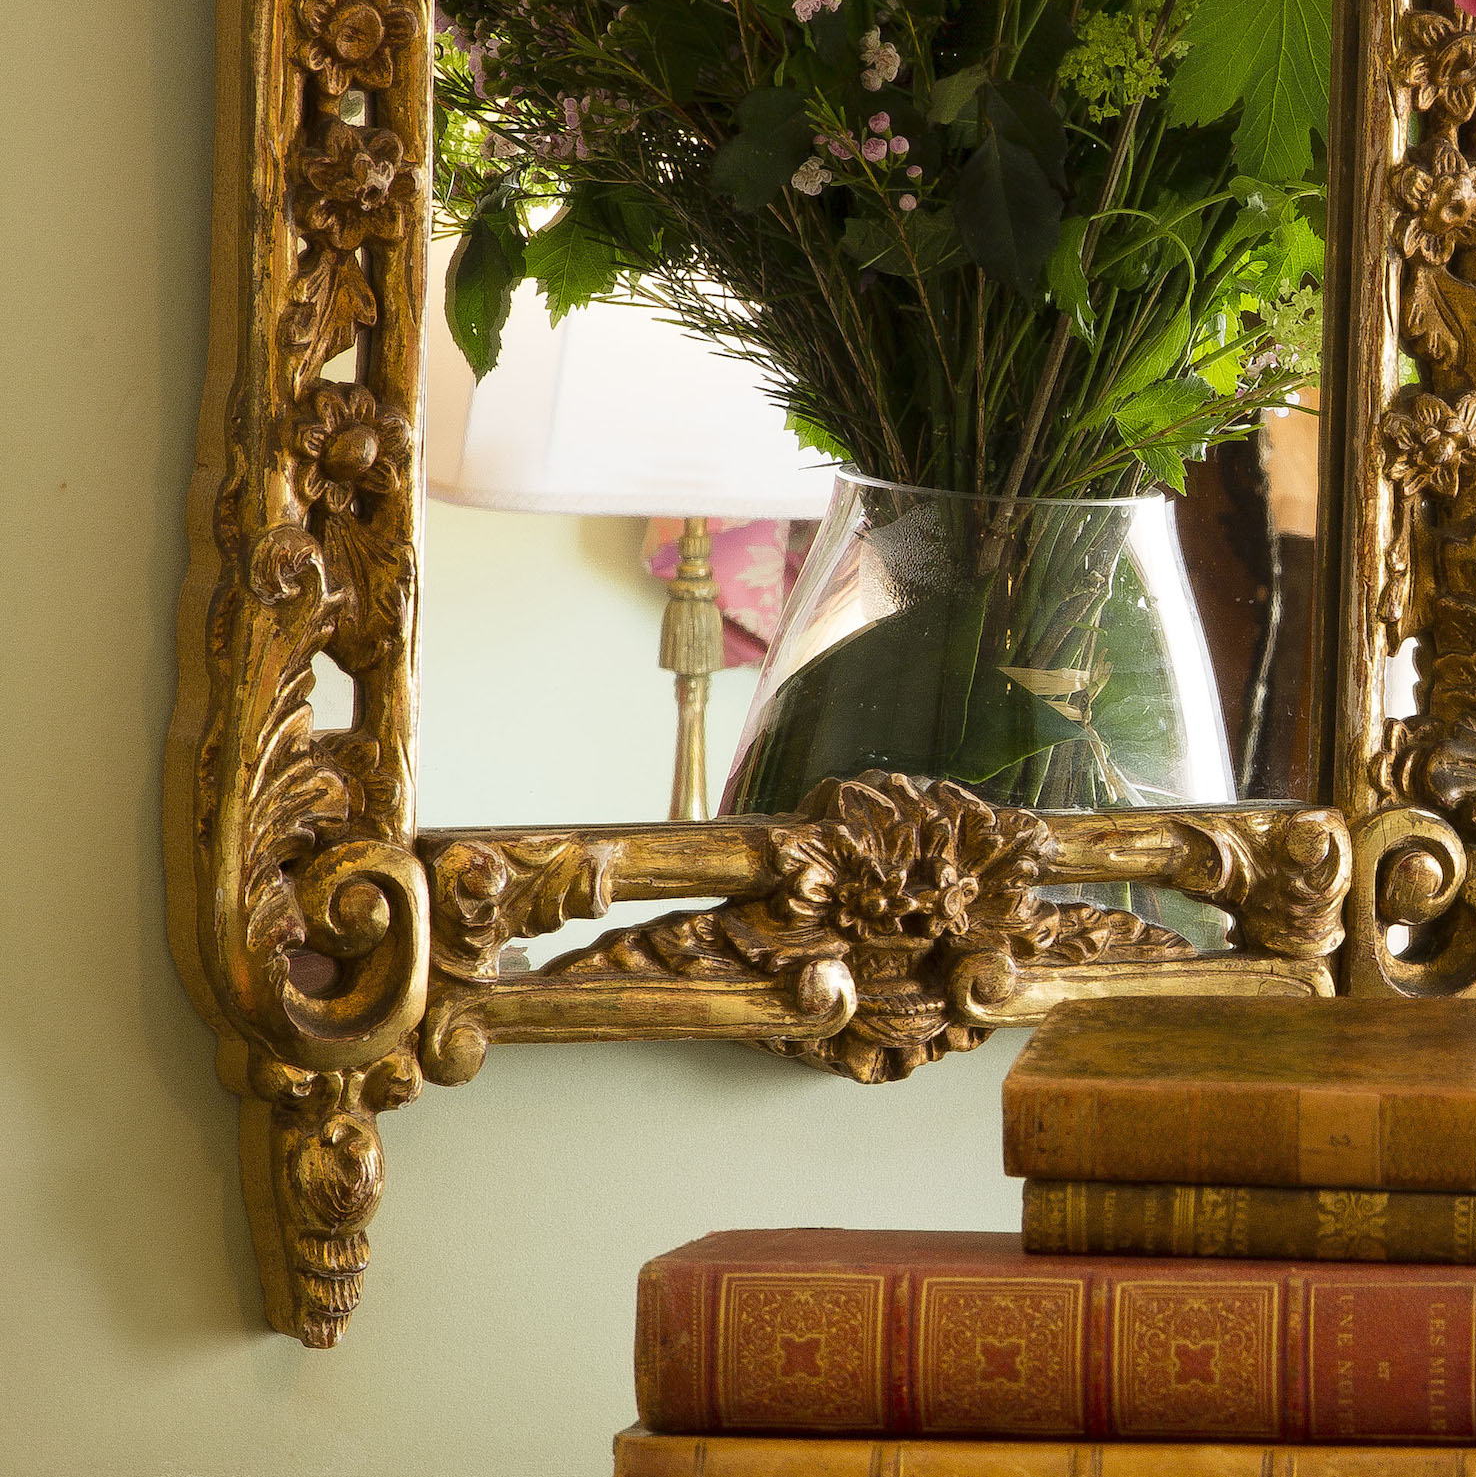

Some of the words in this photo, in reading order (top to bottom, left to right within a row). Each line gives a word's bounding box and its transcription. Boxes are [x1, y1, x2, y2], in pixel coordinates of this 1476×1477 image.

[1337, 1293, 1354, 1346] UNE
[1429, 1302, 1446, 1346] LES
[1337, 1360, 1354, 1435] NUITS
[1429, 1357, 1447, 1431] MILLE
